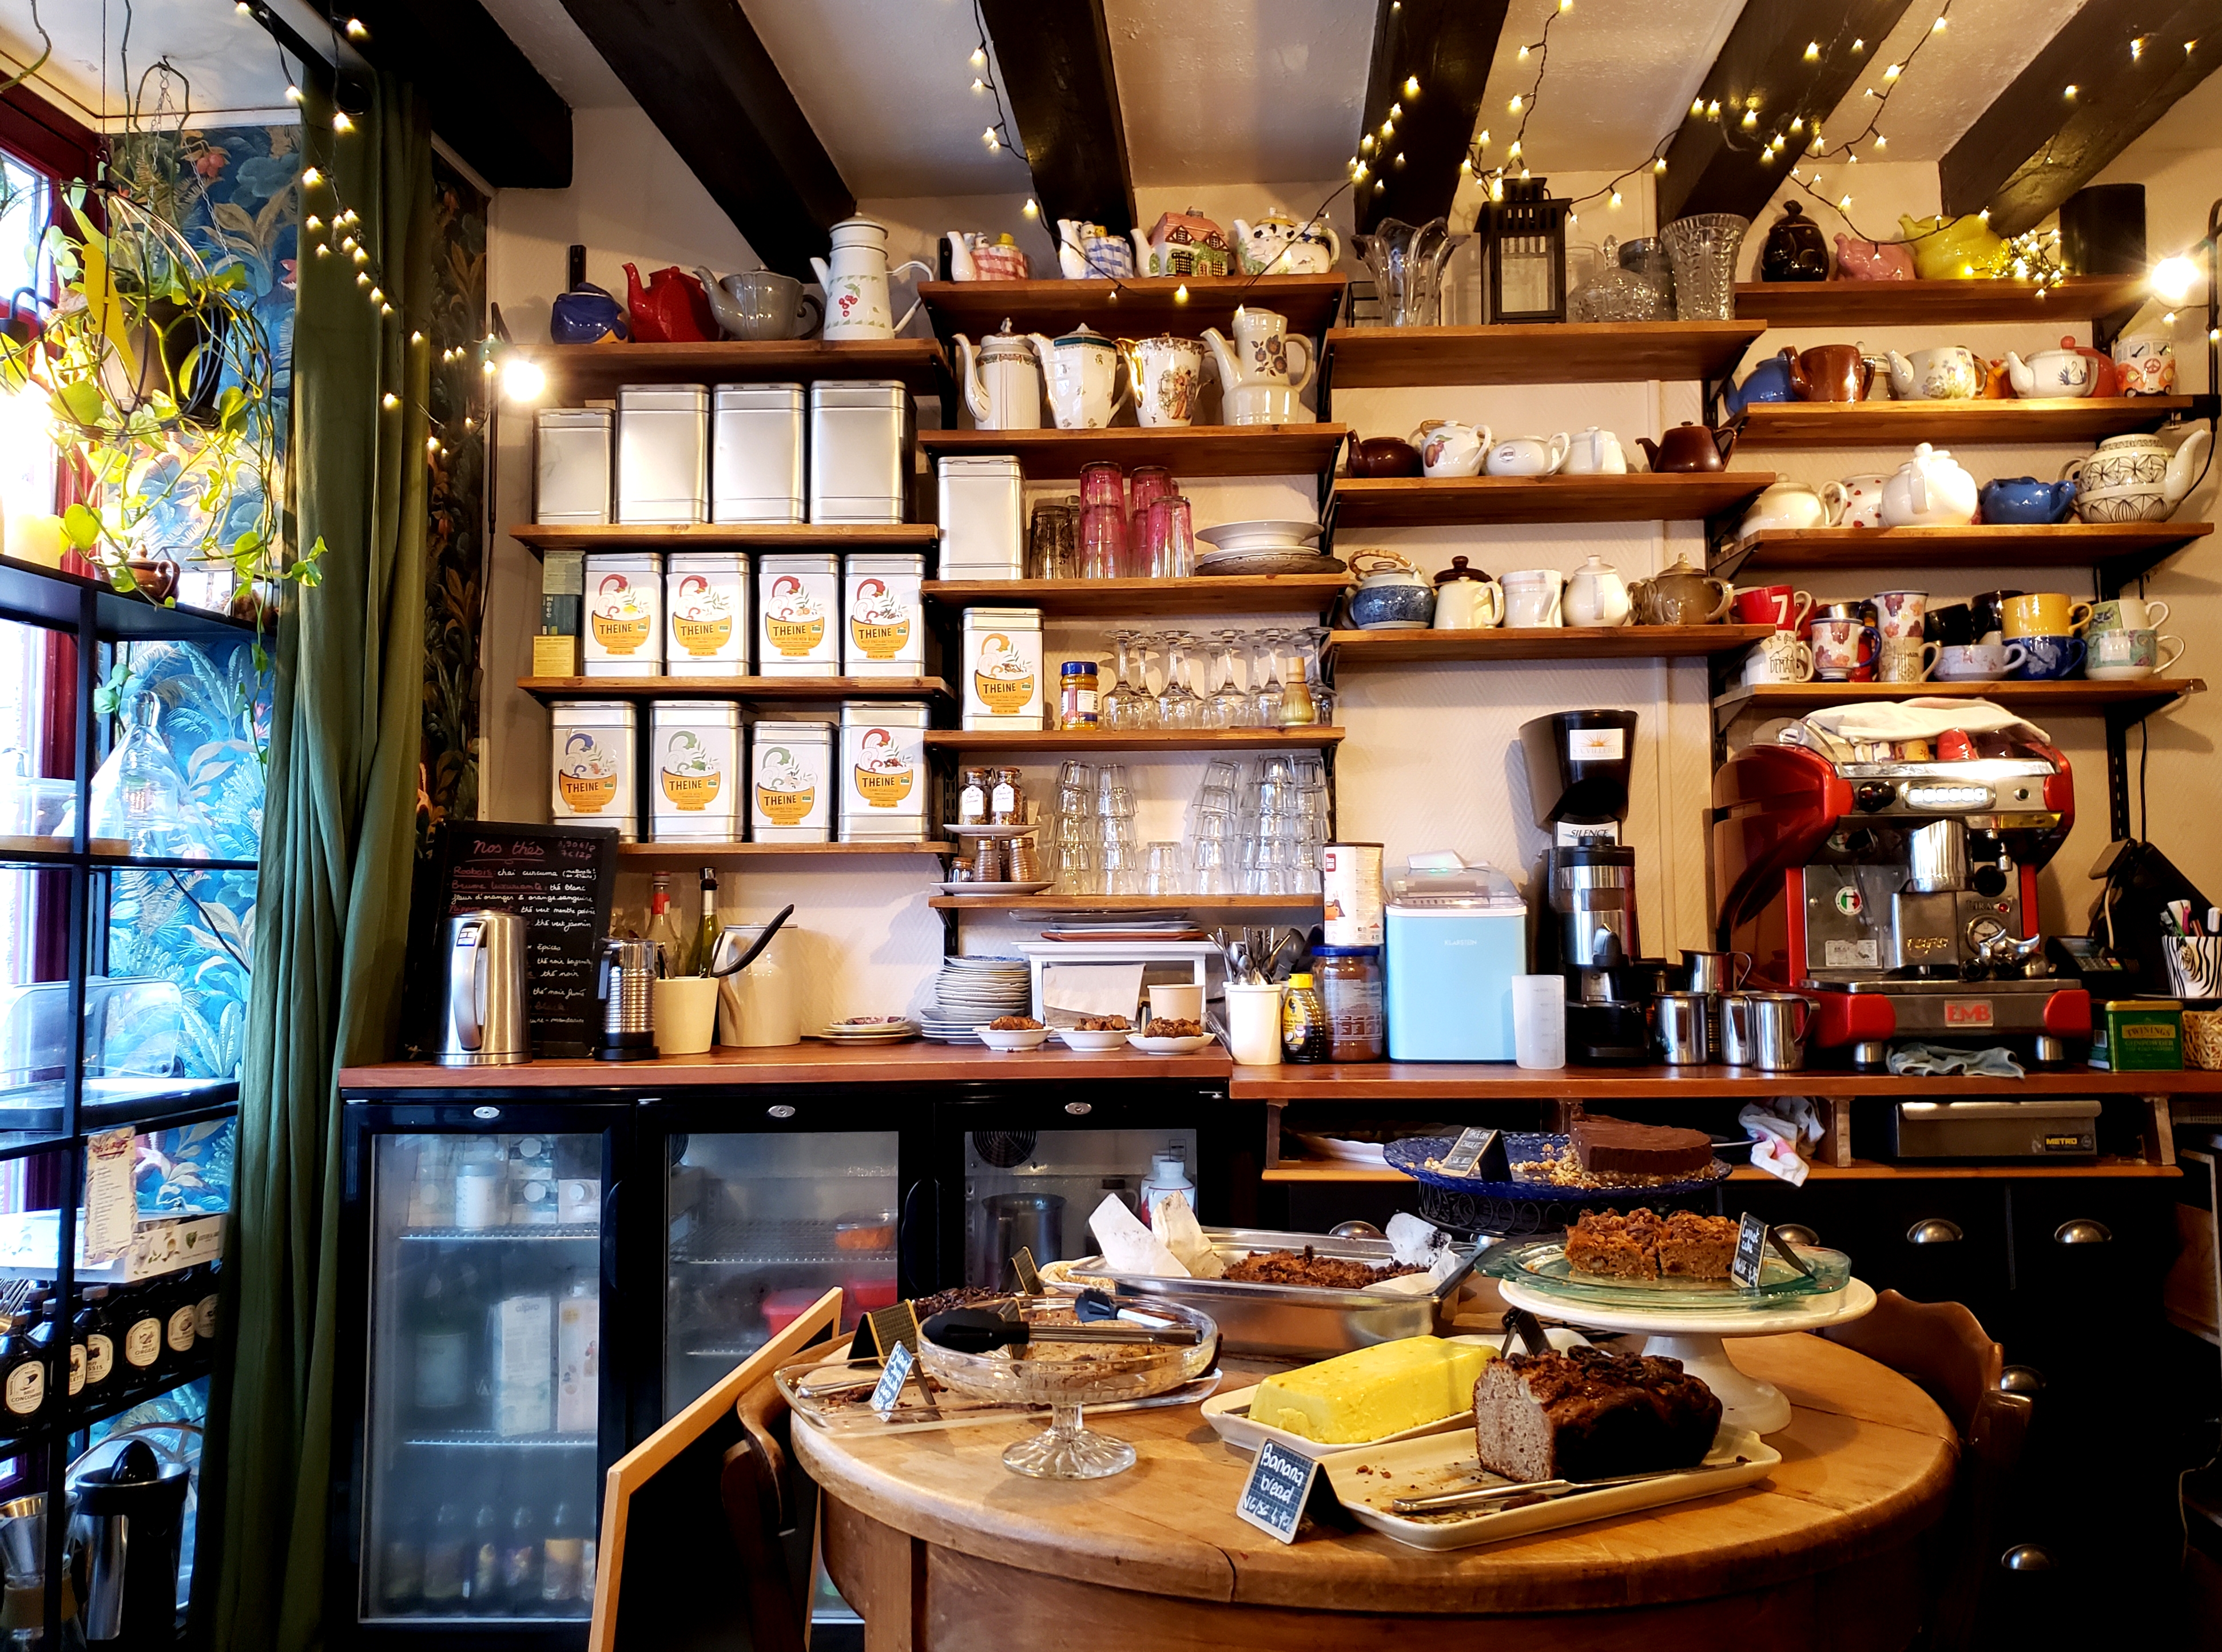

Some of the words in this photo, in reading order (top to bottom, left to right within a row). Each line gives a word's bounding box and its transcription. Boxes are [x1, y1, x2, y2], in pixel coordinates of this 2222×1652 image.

[1771, 595, 1788, 625] 7
[599, 624, 632, 634] THEINE
[681, 625, 714, 636] THEINE
[773, 625, 806, 636] THEINE
[858, 628, 892, 639] THEINE
[983, 683, 1016, 694] THEINE
[566, 782, 599, 793] THEINE
[669, 780, 702, 791] THEINE
[862, 777, 895, 788] THEINE
[764, 795, 797, 806] THEINE
[1571, 829, 1608, 842] SILENCE
[474, 840, 502, 854] Nos
[512, 841, 544, 856] thés
[1946, 1004, 1990, 1022] EMB
[2127, 1027, 2171, 1037] TWININGS
[2046, 1137, 2078, 1145] METRO
[515, 1303, 540, 1315] alpro
[1261, 1443, 1304, 1487] Banana
[1260, 1474, 1295, 1504] bread
